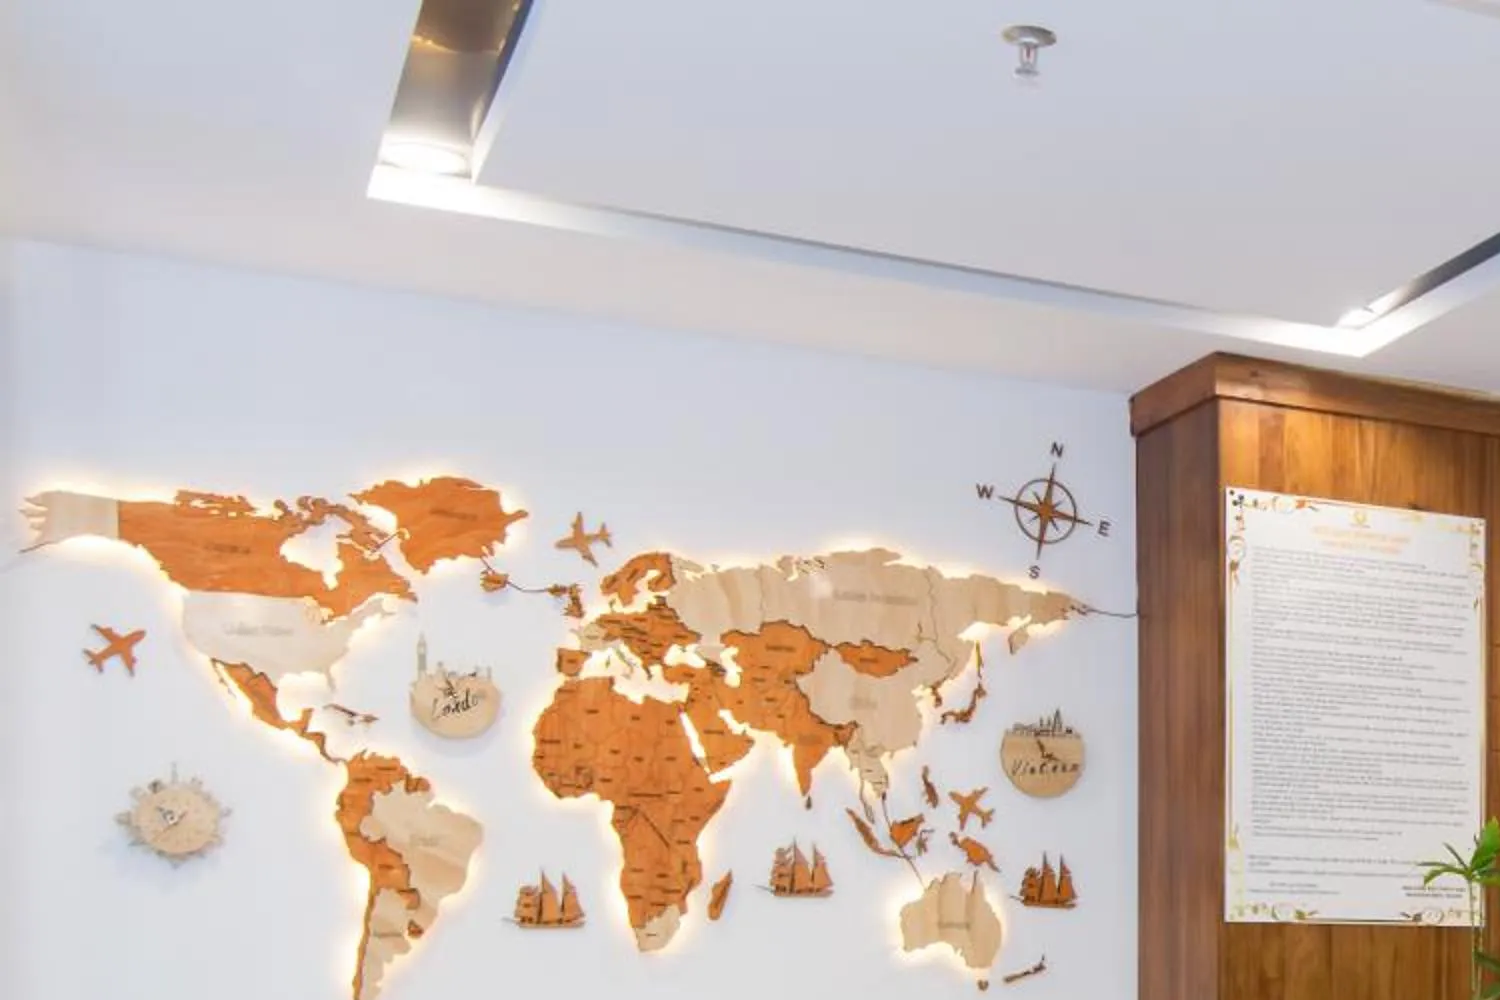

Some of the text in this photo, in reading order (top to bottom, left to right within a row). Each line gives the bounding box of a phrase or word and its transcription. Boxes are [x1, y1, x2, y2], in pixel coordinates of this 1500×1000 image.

[1050, 441, 1064, 458] N
[976, 483, 994, 499] W
[1098, 520, 1112, 537] E
[1028, 564, 1041, 579] S
